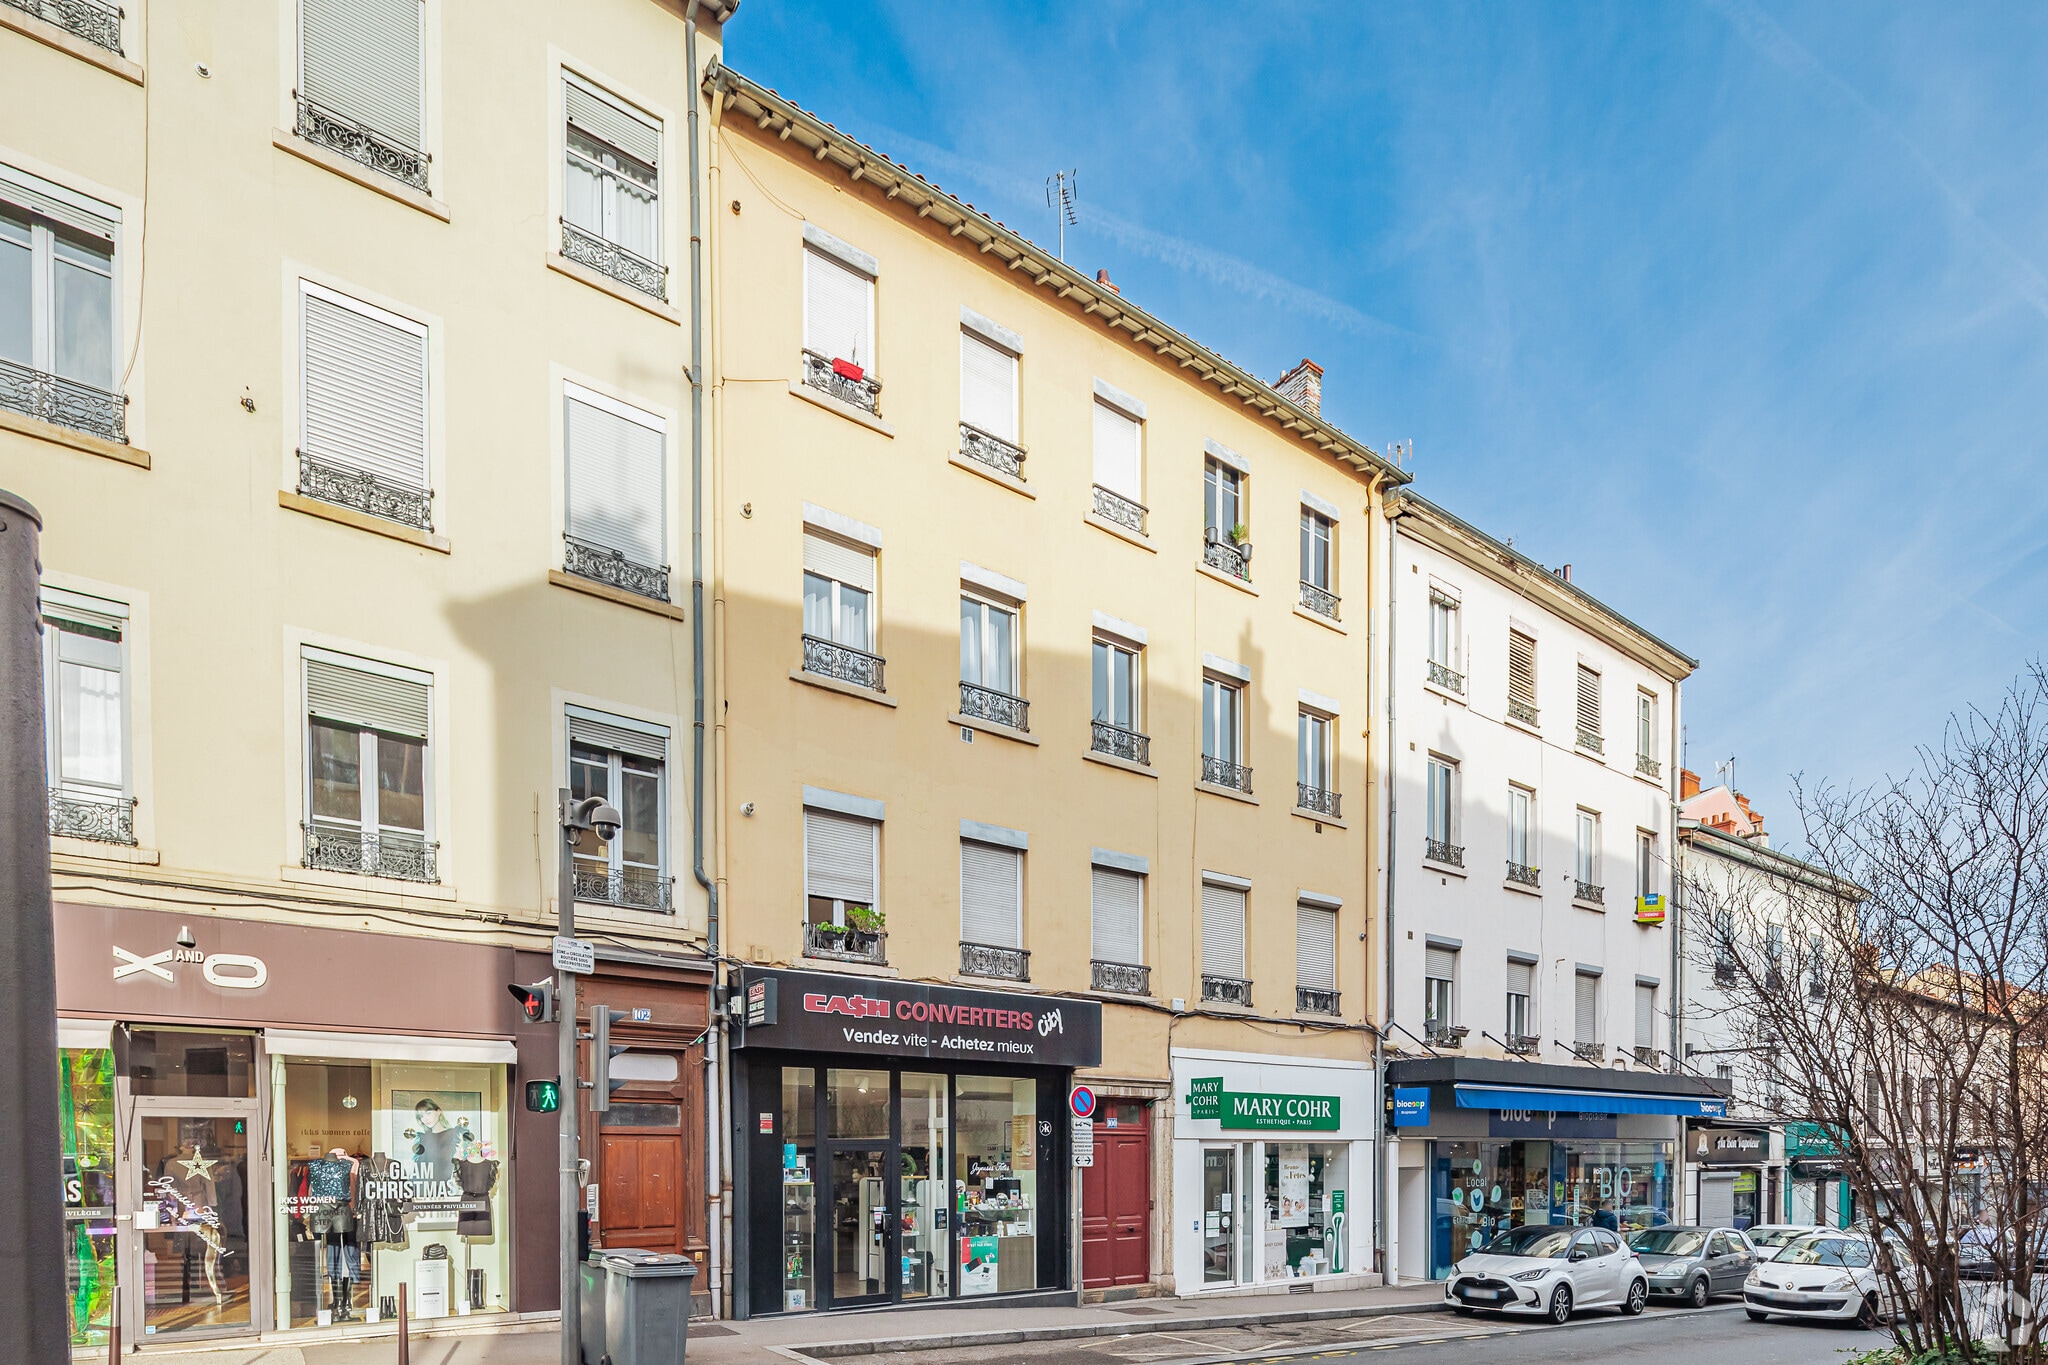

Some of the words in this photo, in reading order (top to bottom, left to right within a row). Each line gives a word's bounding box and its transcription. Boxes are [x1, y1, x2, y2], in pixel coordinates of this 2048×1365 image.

[113, 945, 174, 983] X
[175, 949, 204, 964] AND
[203, 953, 267, 989] O
[634, 1009, 650, 1020] 102
[895, 1000, 1034, 1031] CONVERTERS
[842, 1028, 899, 1045] Vendez
[902, 1032, 928, 1047] vite
[940, 1036, 995, 1052] Achetez
[998, 1040, 1034, 1054] mieux
[1192, 1082, 1219, 1093] MARY
[1192, 1095, 1219, 1106] COHR
[1396, 1100, 1425, 1110] biocoop
[1233, 1097, 1283, 1116] MARY
[1286, 1099, 1332, 1118] COHR
[1256, 1118, 1291, 1126] ESTHETIQUE
[390, 1162, 434, 1180] GLAM
[970, 1162, 994, 1175] Joyeuses
[1466, 1176, 1487, 1188] Local
[148, 1176, 196, 1208] Joyeuses
[365, 1180, 458, 1200] CHRISTMAS
[300, 1196, 336, 1204] WOMEN
[443, 1202, 477, 1210] PRIVILÈGES
[279, 1206, 298, 1214] ONE
[300, 1206, 320, 1214] STEP
